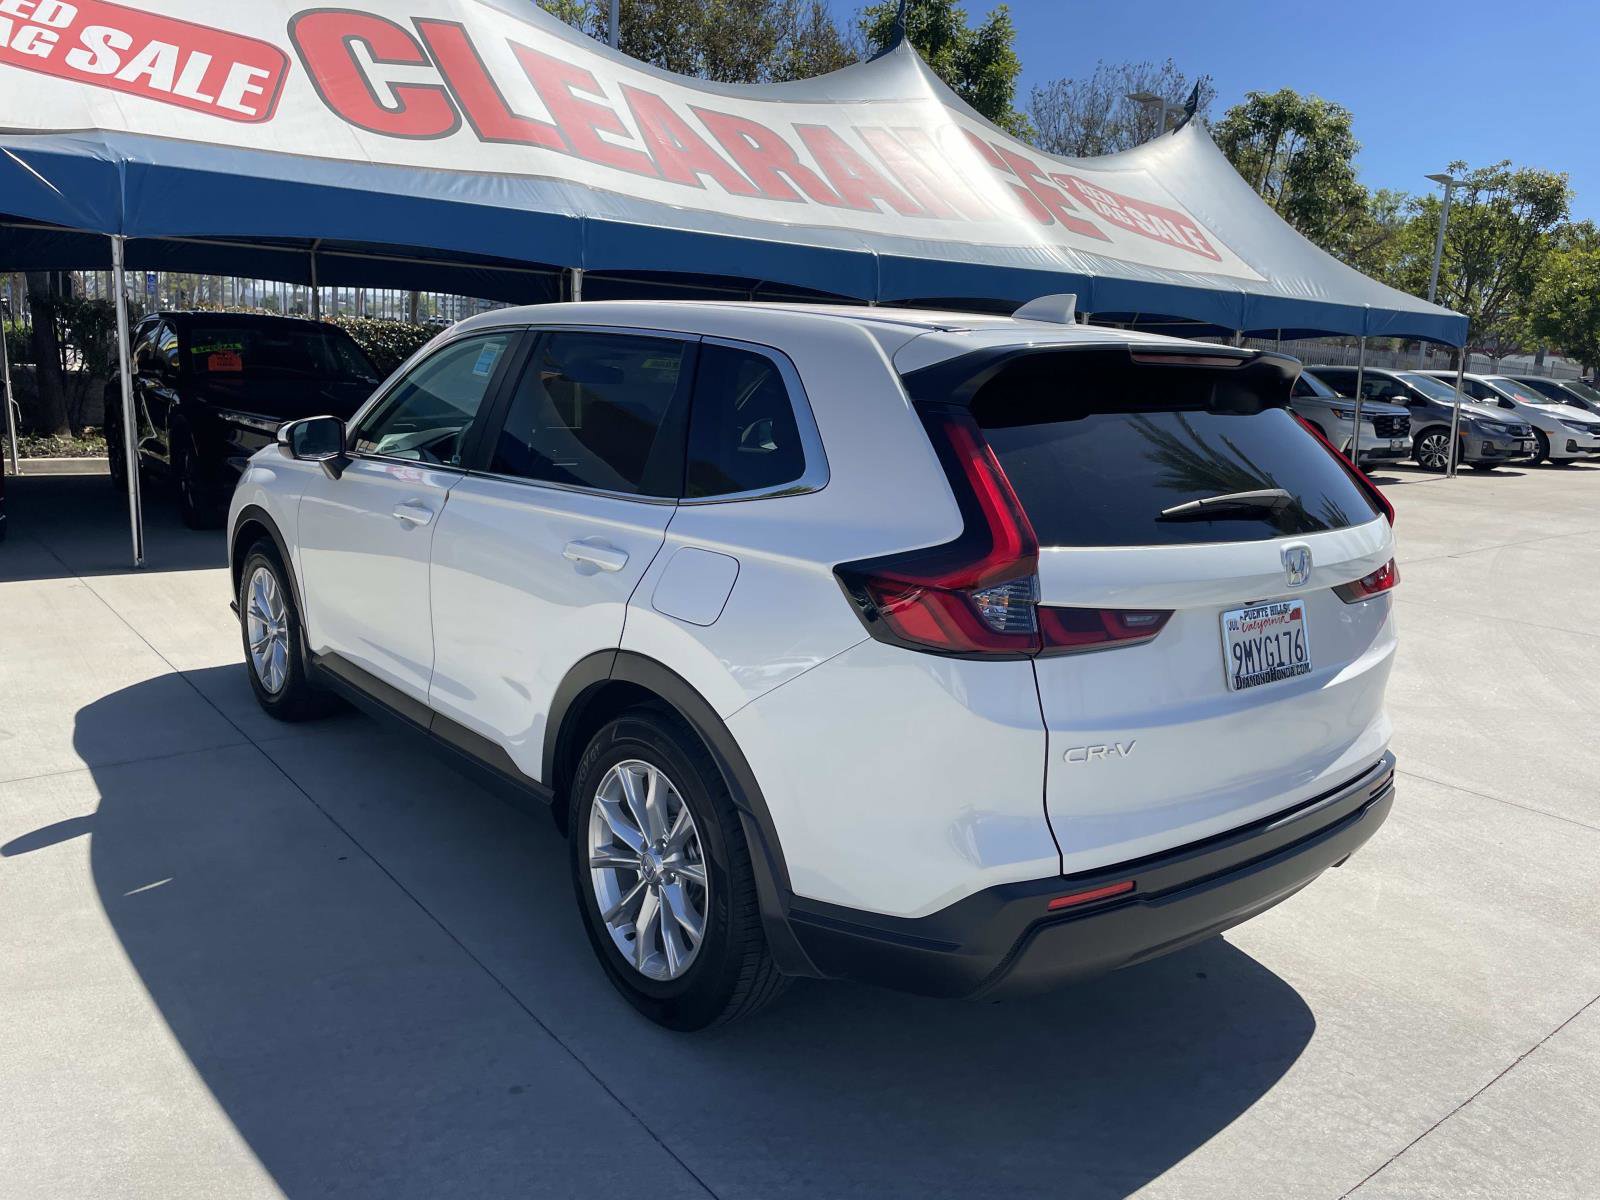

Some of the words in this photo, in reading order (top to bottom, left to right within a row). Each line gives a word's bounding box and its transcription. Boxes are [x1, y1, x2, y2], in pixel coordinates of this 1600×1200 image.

[65, 25, 270, 116] SALE
[1084, 195, 1135, 226] TAG
[1124, 206, 1216, 256] SALE
[1229, 620, 1240, 631] JUL
[1242, 616, 1290, 634] California
[1244, 607, 1269, 621] PUENTE
[1269, 603, 1289, 616] HILLS
[1233, 628, 1303, 675] 9MYG176
[1063, 739, 1137, 764] CR-V
